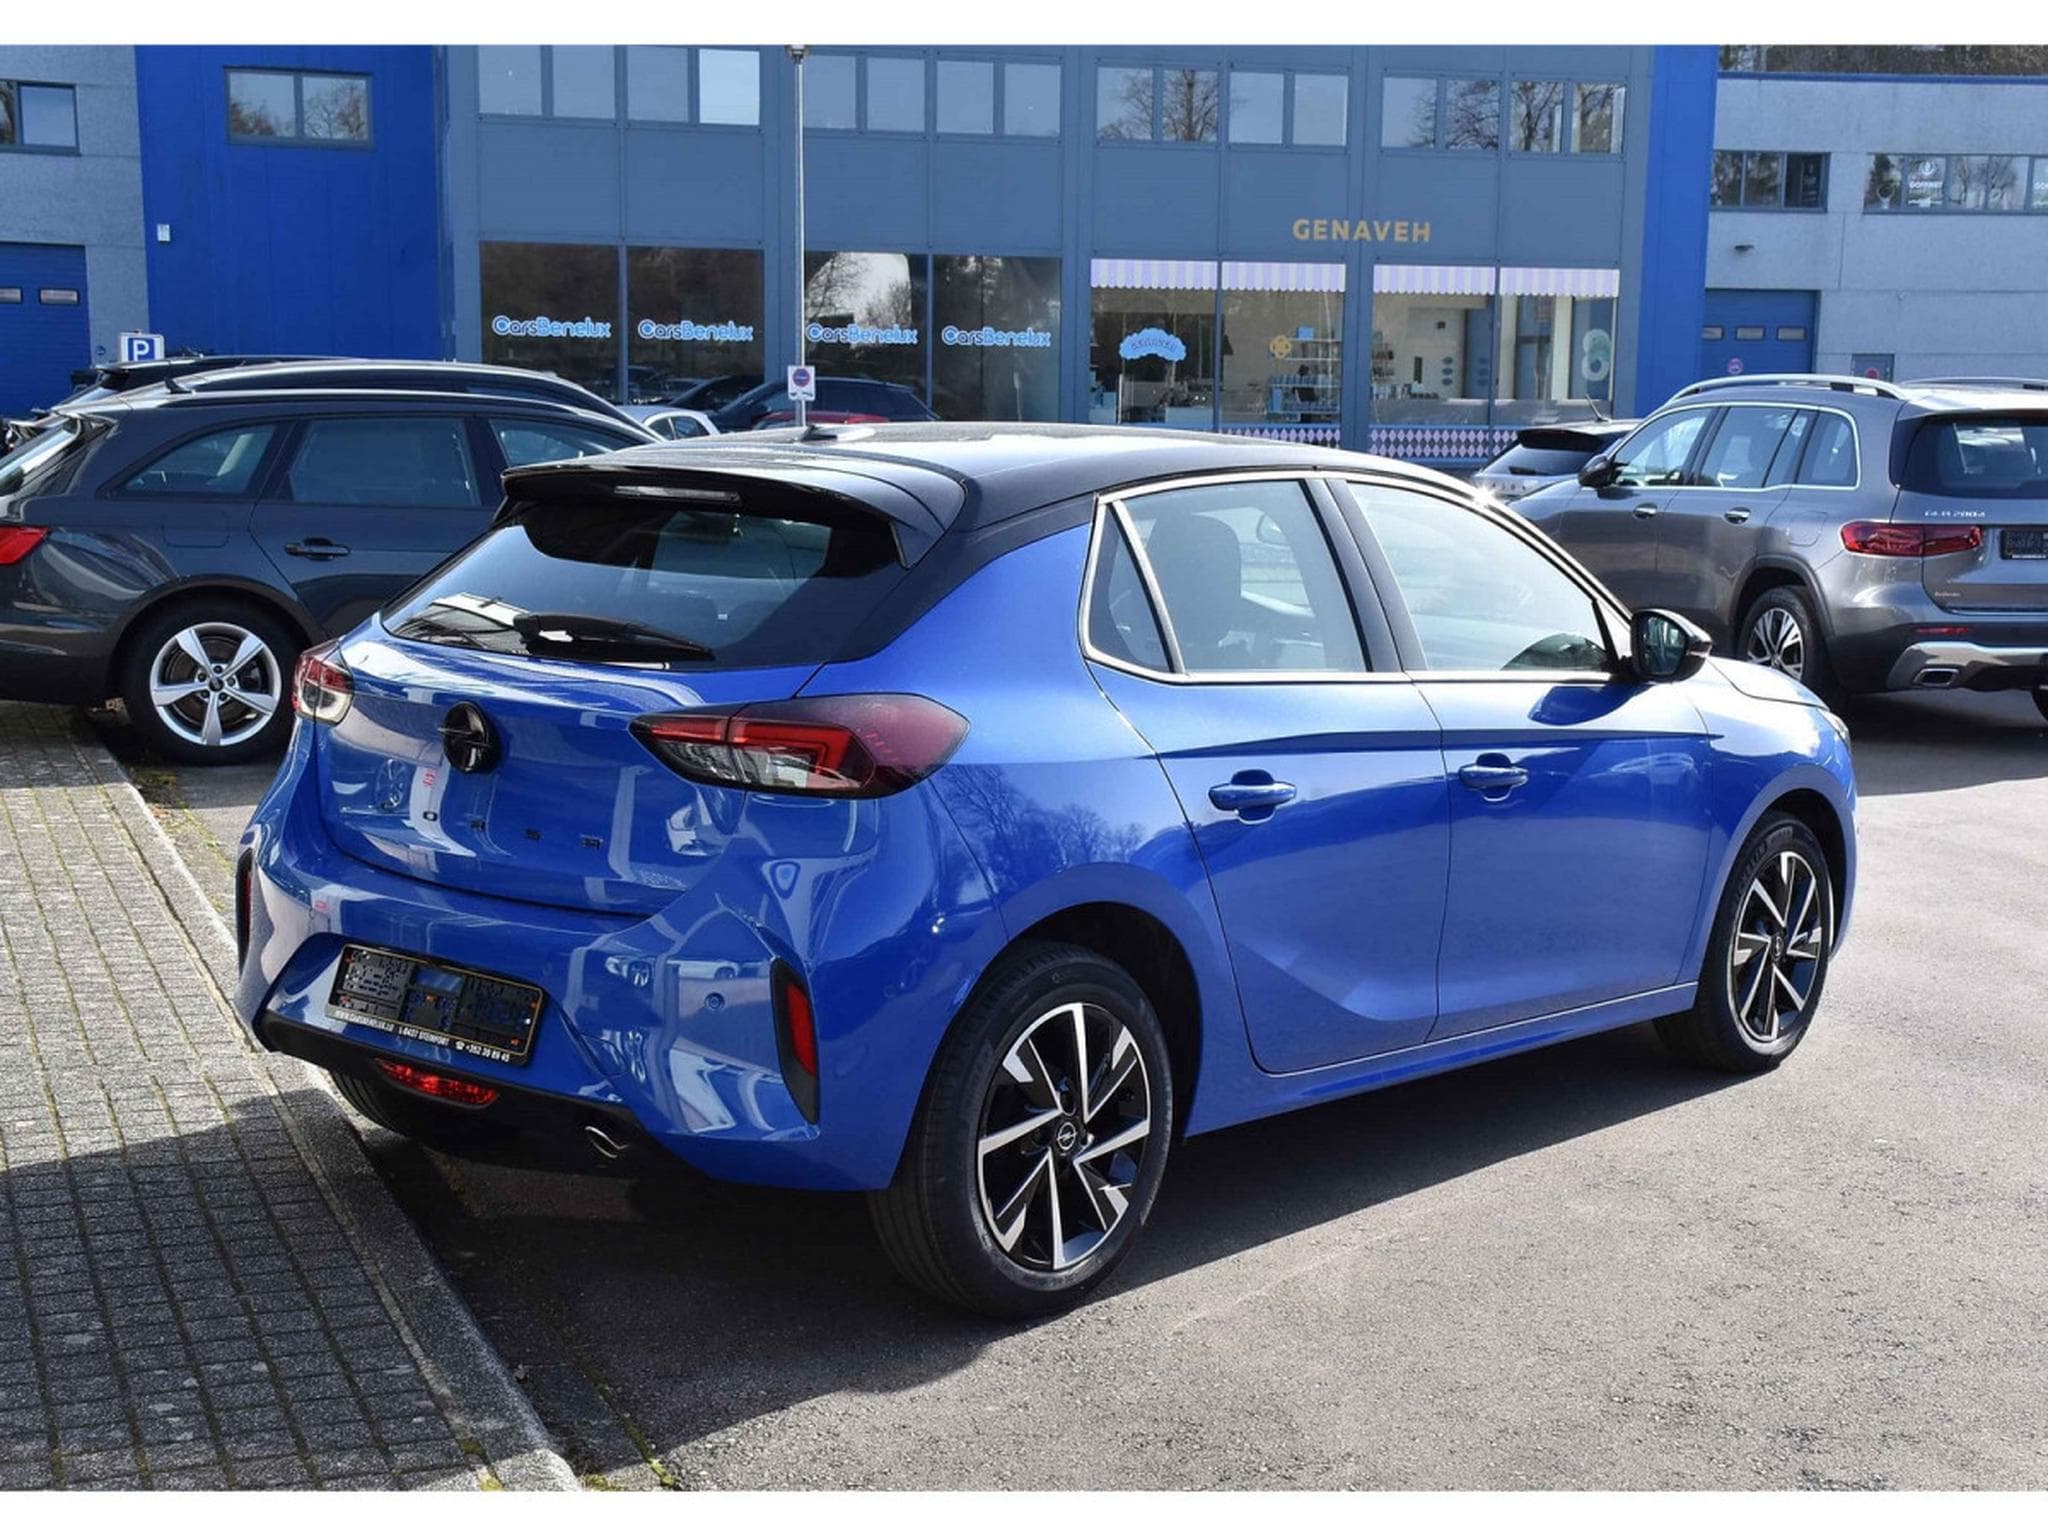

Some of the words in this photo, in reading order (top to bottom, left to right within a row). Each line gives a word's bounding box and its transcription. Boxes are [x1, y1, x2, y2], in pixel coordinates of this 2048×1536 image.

[1292, 218, 1431, 242] GENAVEH
[492, 315, 611, 338] CarsBenelux
[638, 319, 754, 341] CarsBenelux
[806, 323, 918, 345] CarsBenelux
[942, 326, 1051, 347] CarsBenelux
[133, 340, 149, 361] P
